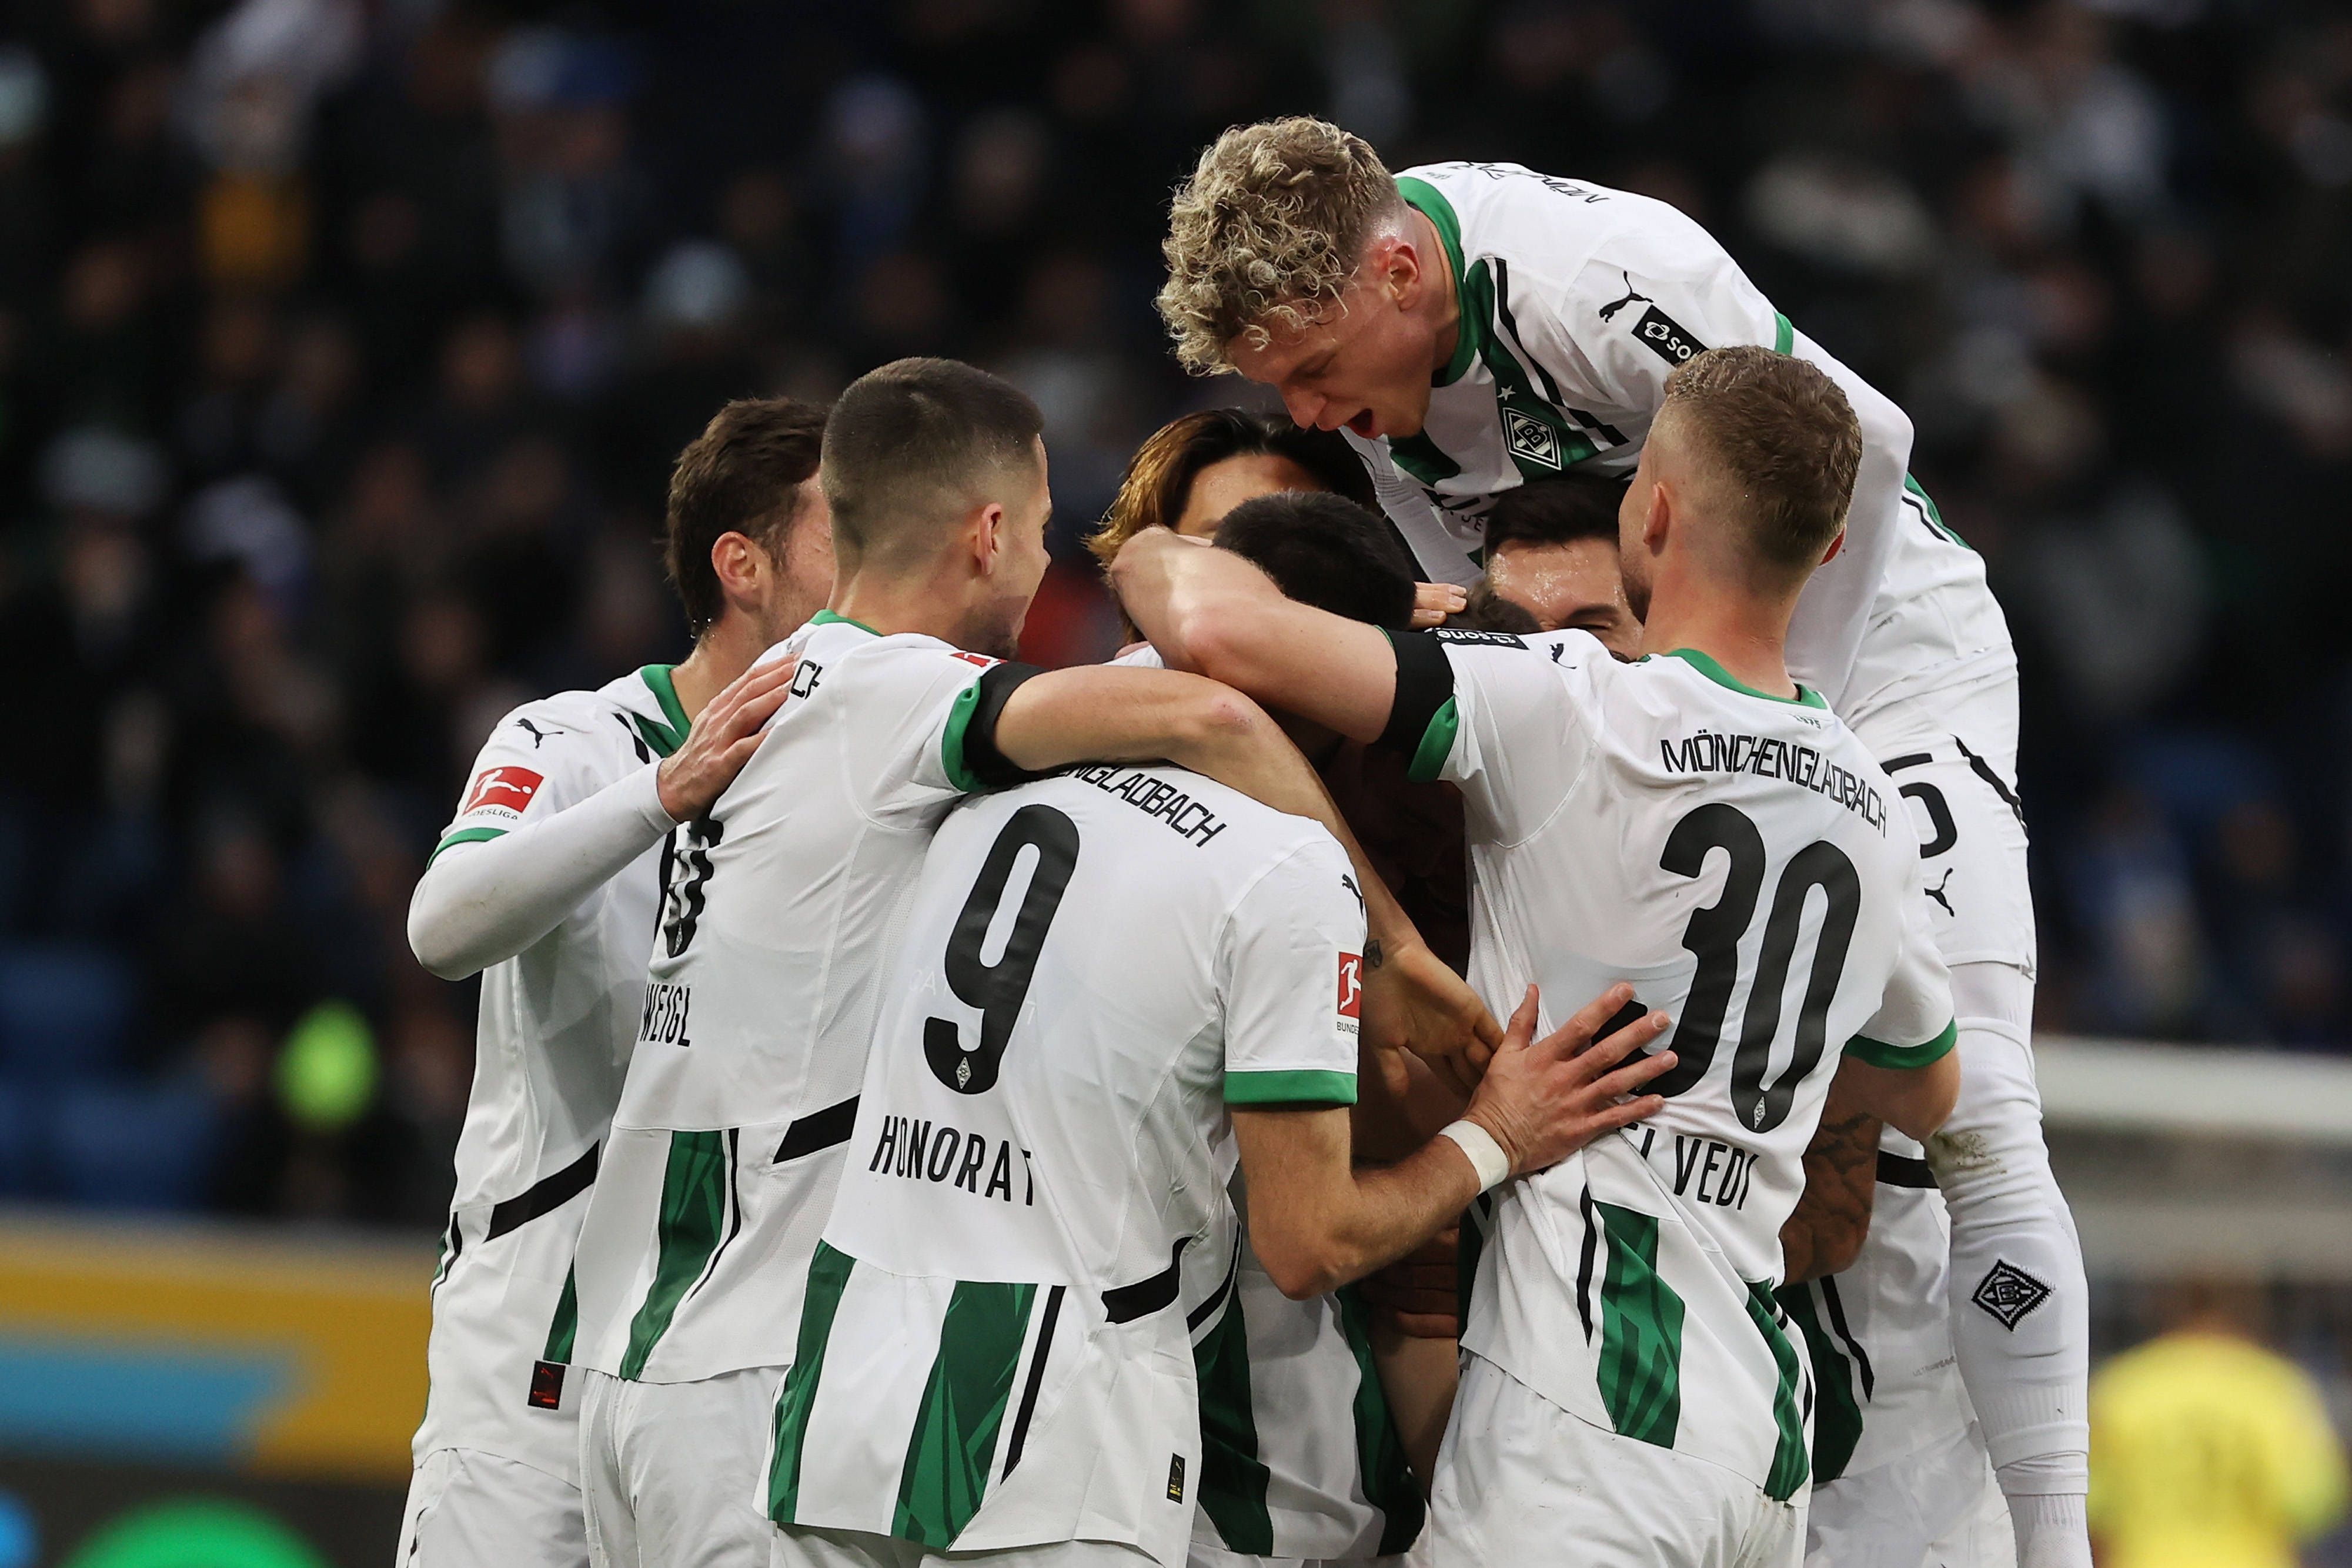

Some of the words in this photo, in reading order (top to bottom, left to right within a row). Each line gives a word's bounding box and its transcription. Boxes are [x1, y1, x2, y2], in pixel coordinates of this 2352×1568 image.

[1660, 729, 1887, 839] MÖNCHENGLADBACH
[923, 803, 1080, 1095] 9
[1591, 803, 1861, 1134] 30
[868, 1115, 1033, 1206] HONORAT
